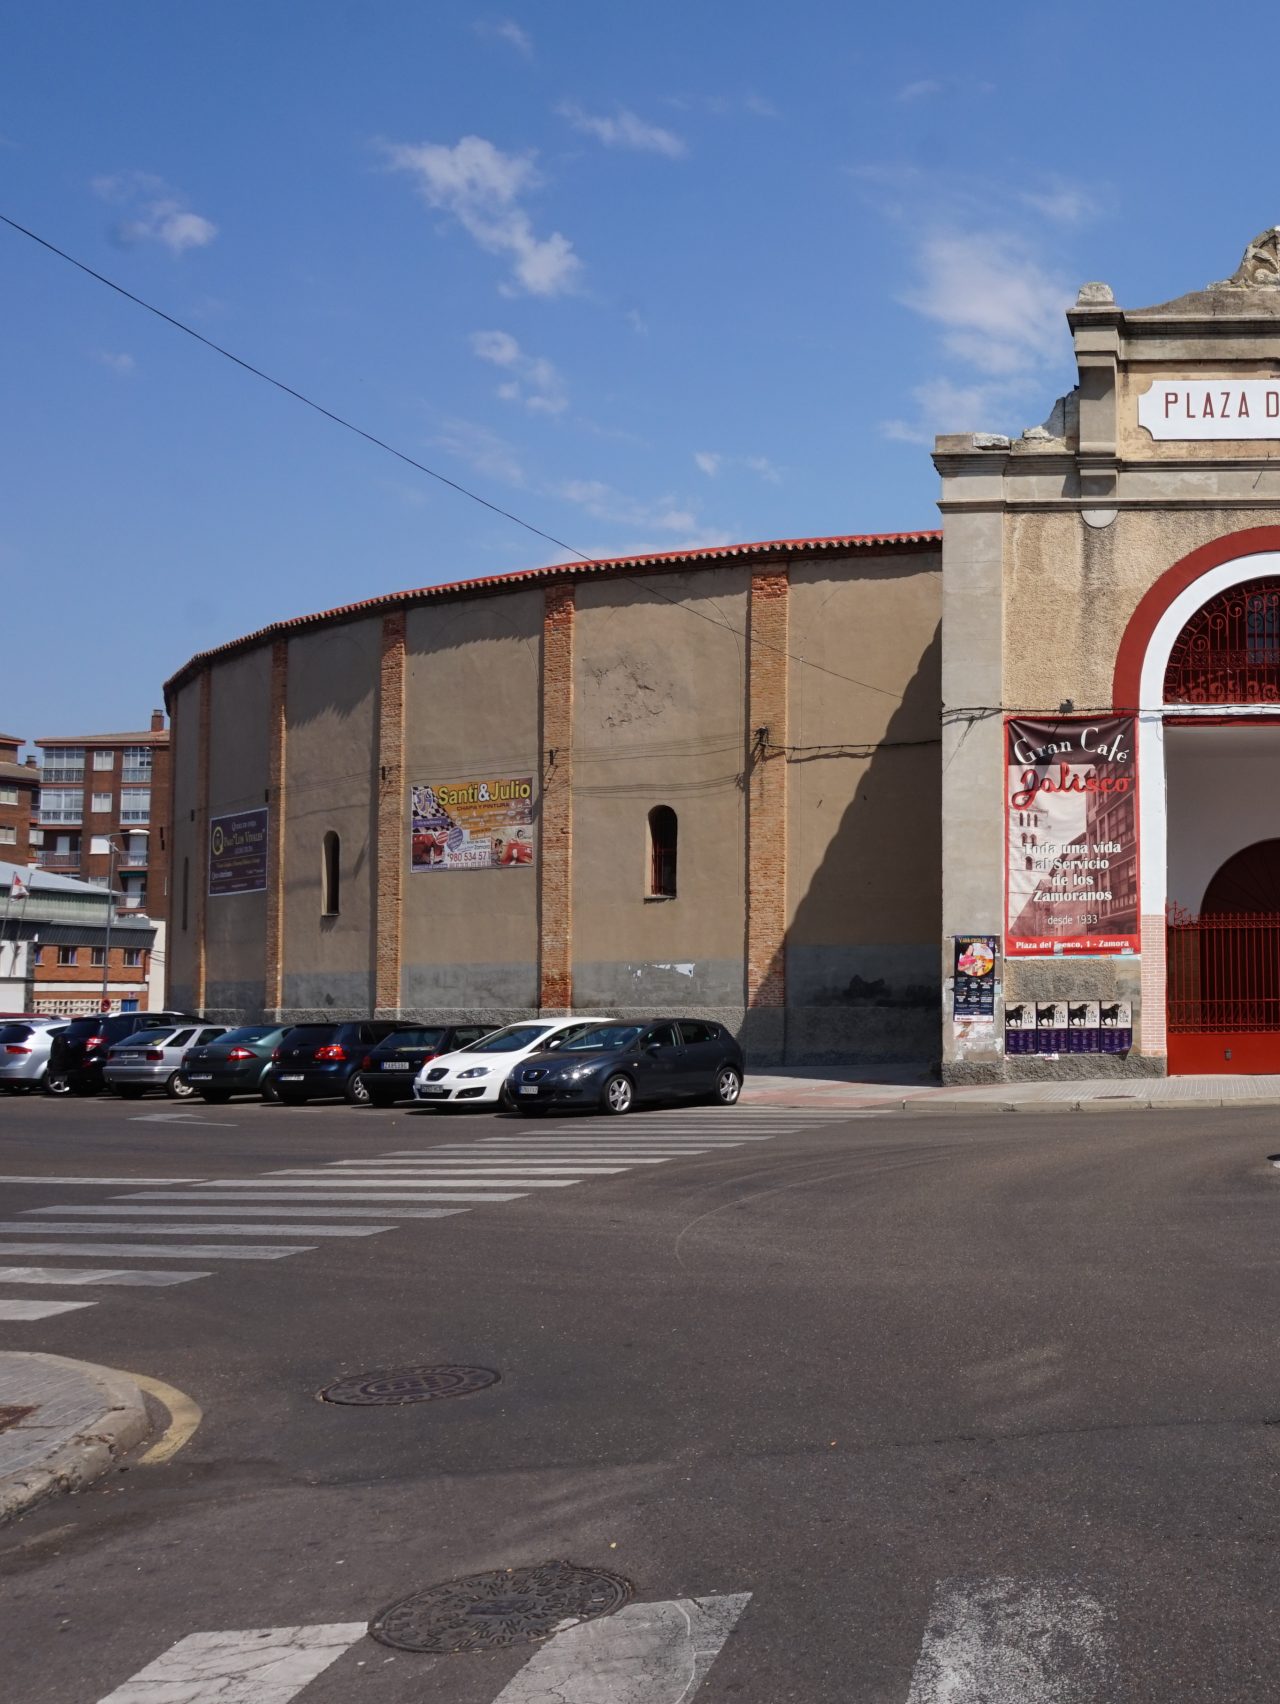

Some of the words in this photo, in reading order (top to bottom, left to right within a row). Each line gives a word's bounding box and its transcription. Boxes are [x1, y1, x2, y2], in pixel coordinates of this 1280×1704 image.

[1164, 391, 1250, 419] PLAZA
[1014, 738, 1073, 764] Gran
[1080, 726, 1130, 763] Café
[439, 780, 531, 805] Santi&Julio
[1012, 762, 1132, 811] Jalisco
[1024, 841, 1056, 854] Toda
[1061, 843, 1088, 854] una
[1093, 841, 1121, 853] vida
[1035, 858, 1049, 870] al
[1053, 857, 1110, 870] Servicio
[1052, 874, 1067, 886] de
[1073, 873, 1094, 885] los
[1033, 889, 1113, 901] Zamoranos
[1048, 915, 1073, 925] desde
[1077, 914, 1098, 924] 1933
[1015, 941, 1037, 949] Plaza
